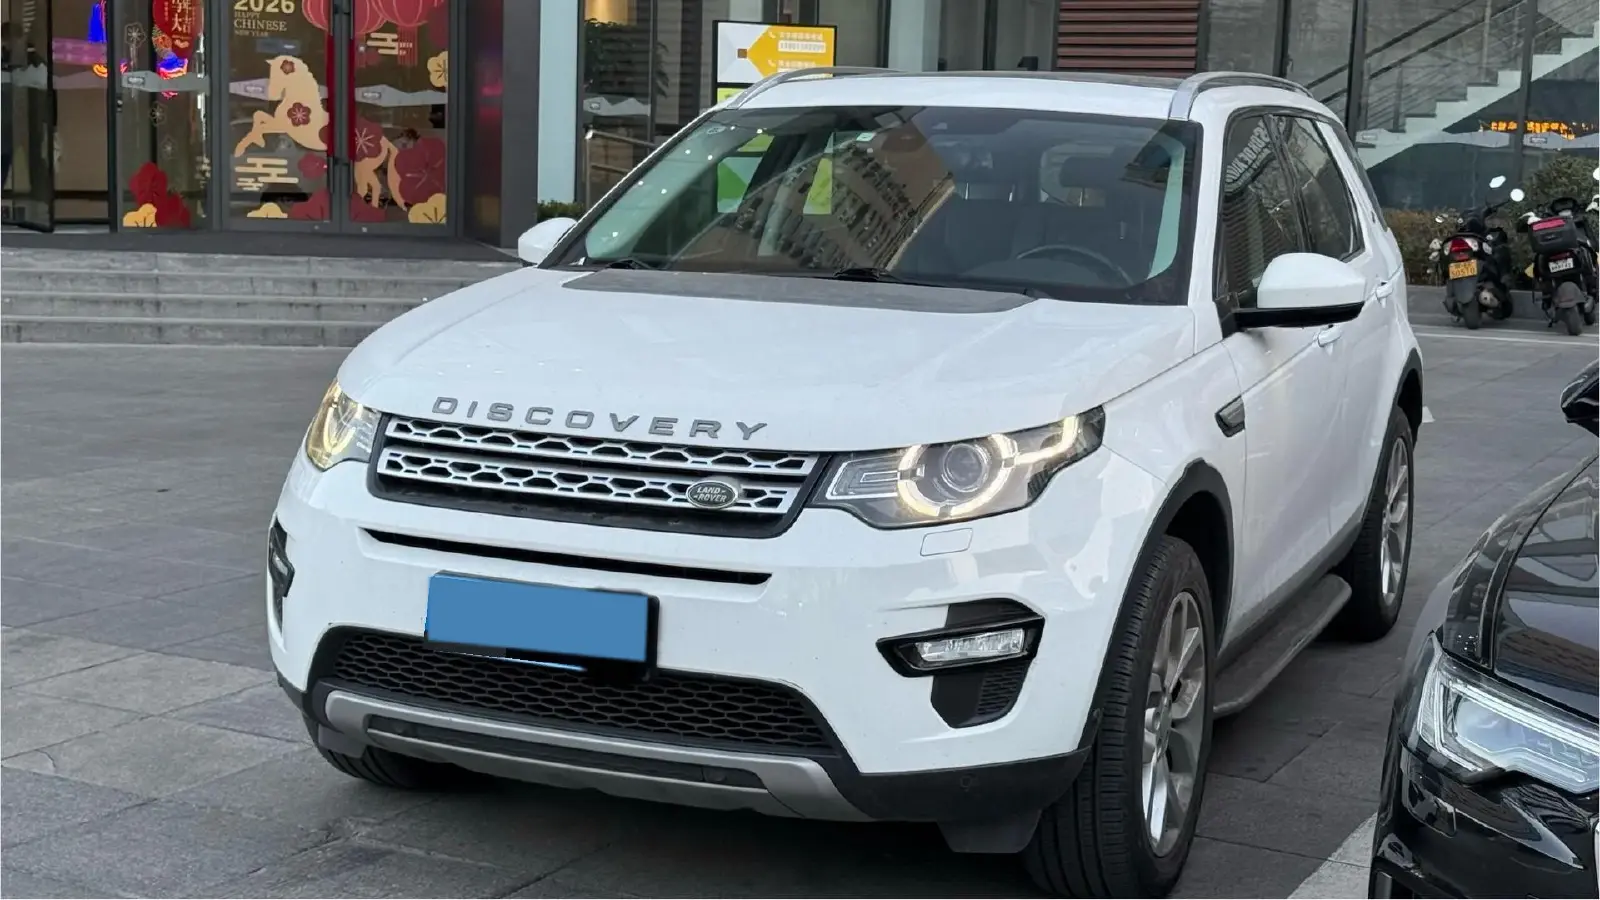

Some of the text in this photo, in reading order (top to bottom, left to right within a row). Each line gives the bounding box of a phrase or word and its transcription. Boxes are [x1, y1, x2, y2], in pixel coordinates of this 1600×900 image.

[234, 0, 295, 14] 2026
[234, 19, 287, 31] CHINESE
[432, 396, 767, 440] DISCOVERY
